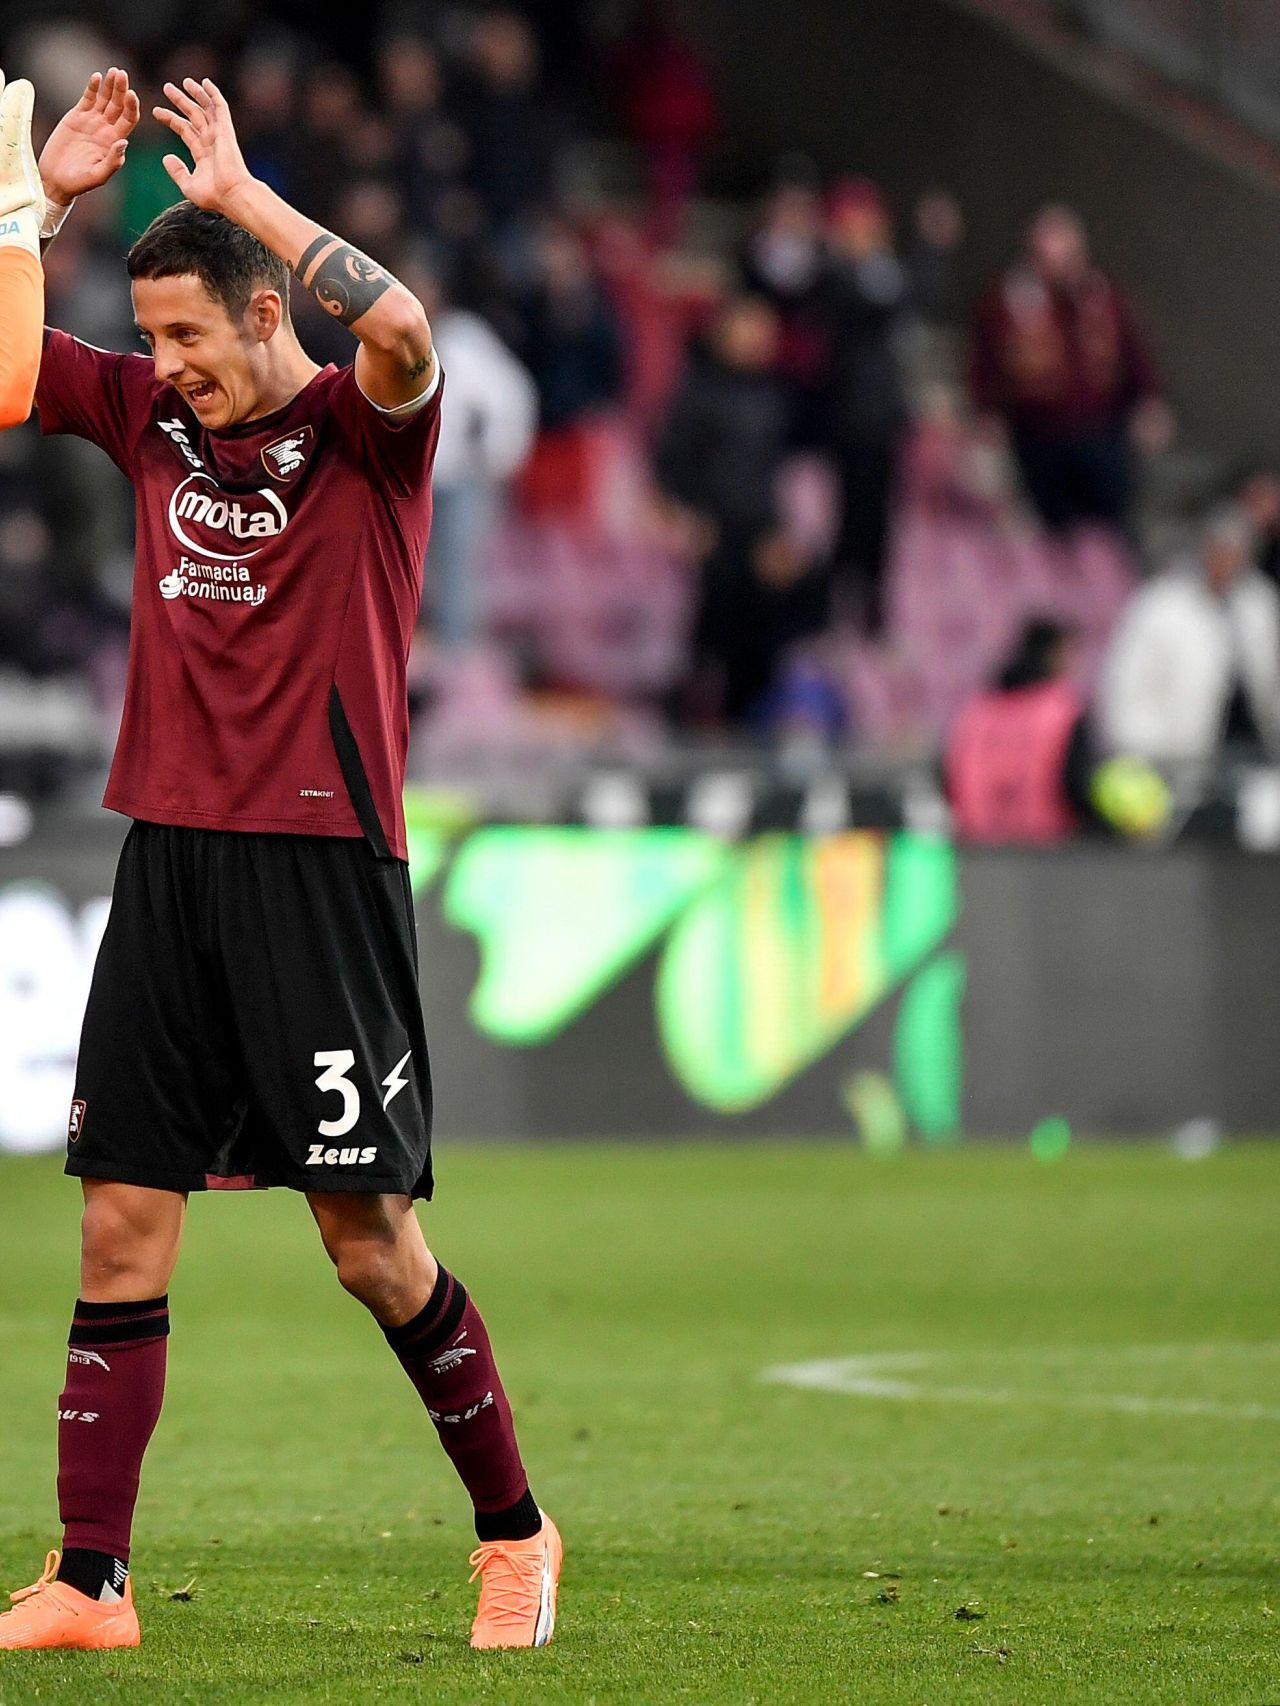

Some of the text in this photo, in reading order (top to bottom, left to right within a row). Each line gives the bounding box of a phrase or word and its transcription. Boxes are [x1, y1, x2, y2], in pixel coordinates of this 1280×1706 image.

[157, 418, 204, 468] Zeus
[179, 556, 250, 582] Farmacia
[181, 576, 267, 606] Continua.it
[313, 1049, 361, 1137] 3
[305, 1144, 378, 1165] Zeus
[58, 1409, 100, 1423] us
